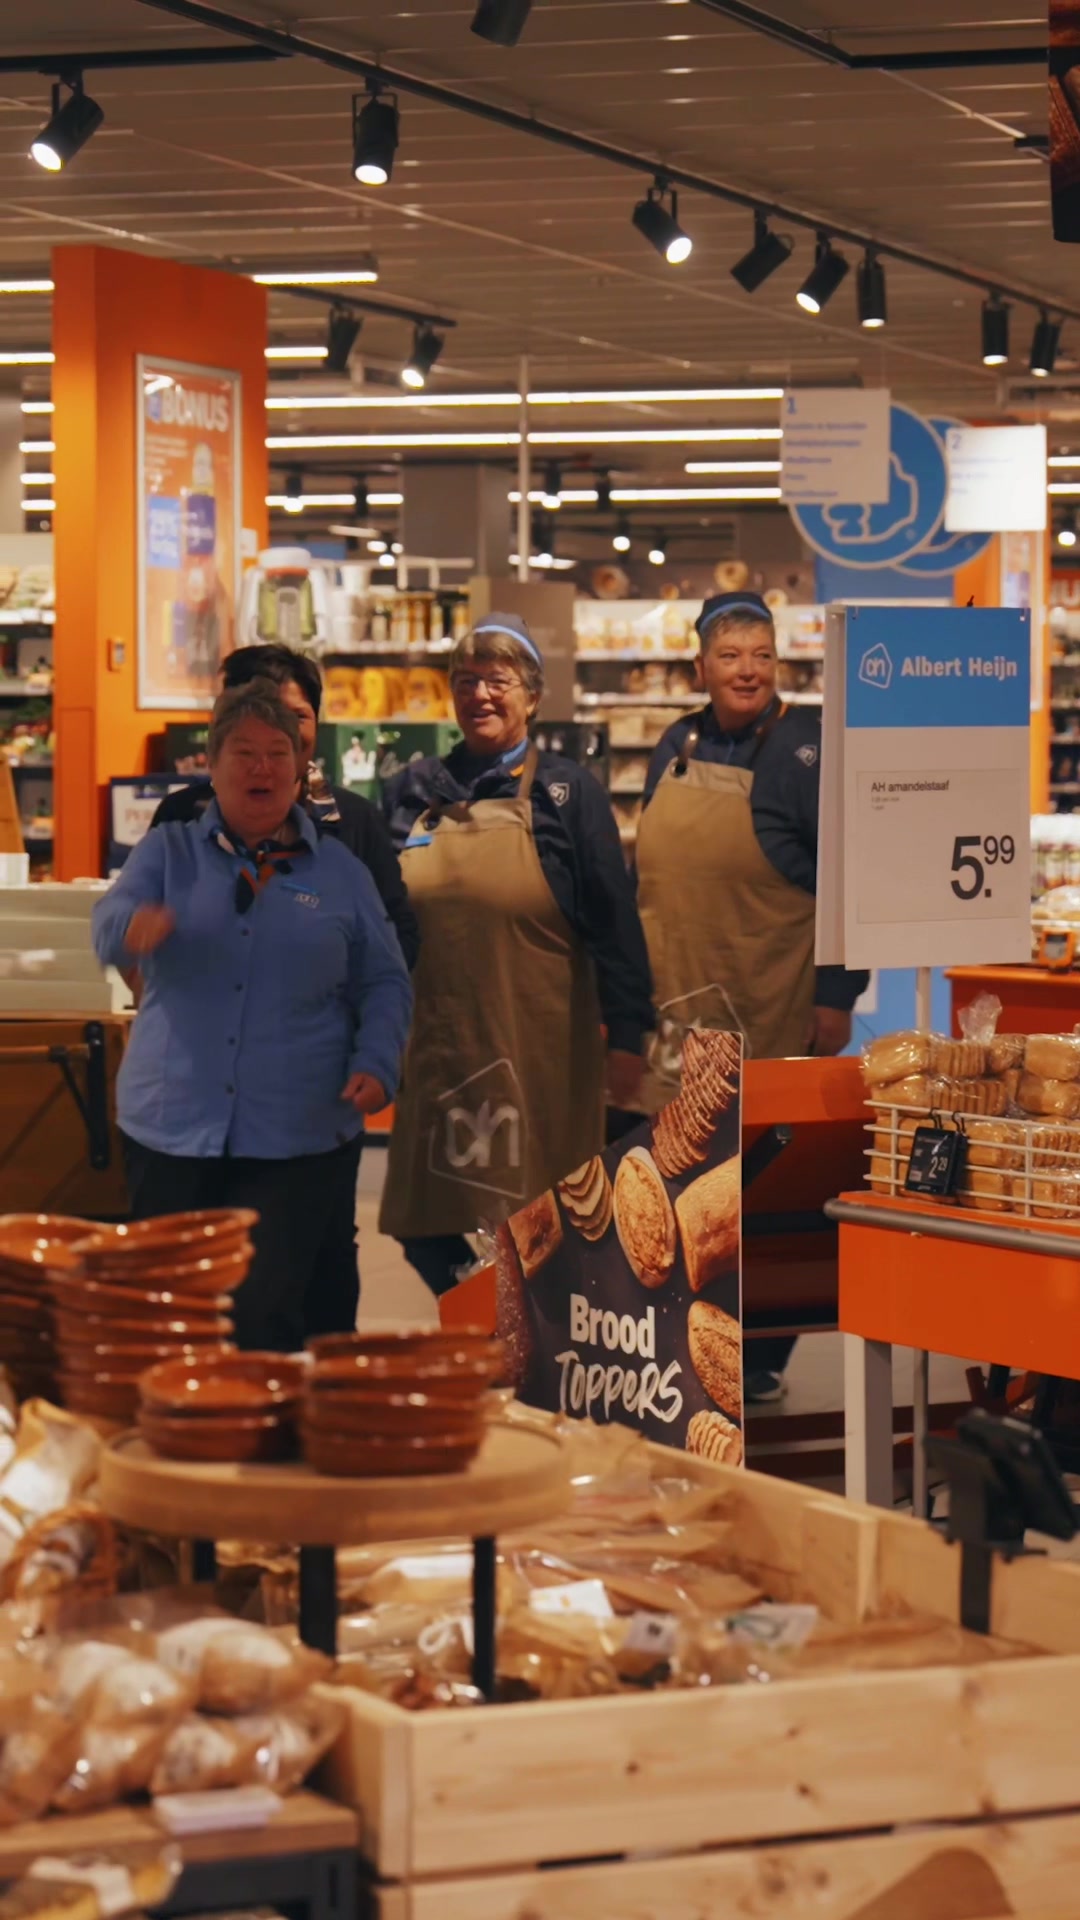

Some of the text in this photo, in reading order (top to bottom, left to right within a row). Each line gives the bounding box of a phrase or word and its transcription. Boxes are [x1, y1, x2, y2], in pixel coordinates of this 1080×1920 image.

[162, 387, 229, 433] BONUS
[786, 397, 797, 414] 1
[900, 656, 962, 677] Albert
[968, 656, 1018, 681] Heijn
[871, 780, 950, 792] AH amandelstaaf
[570, 1293, 655, 1359] Brood
